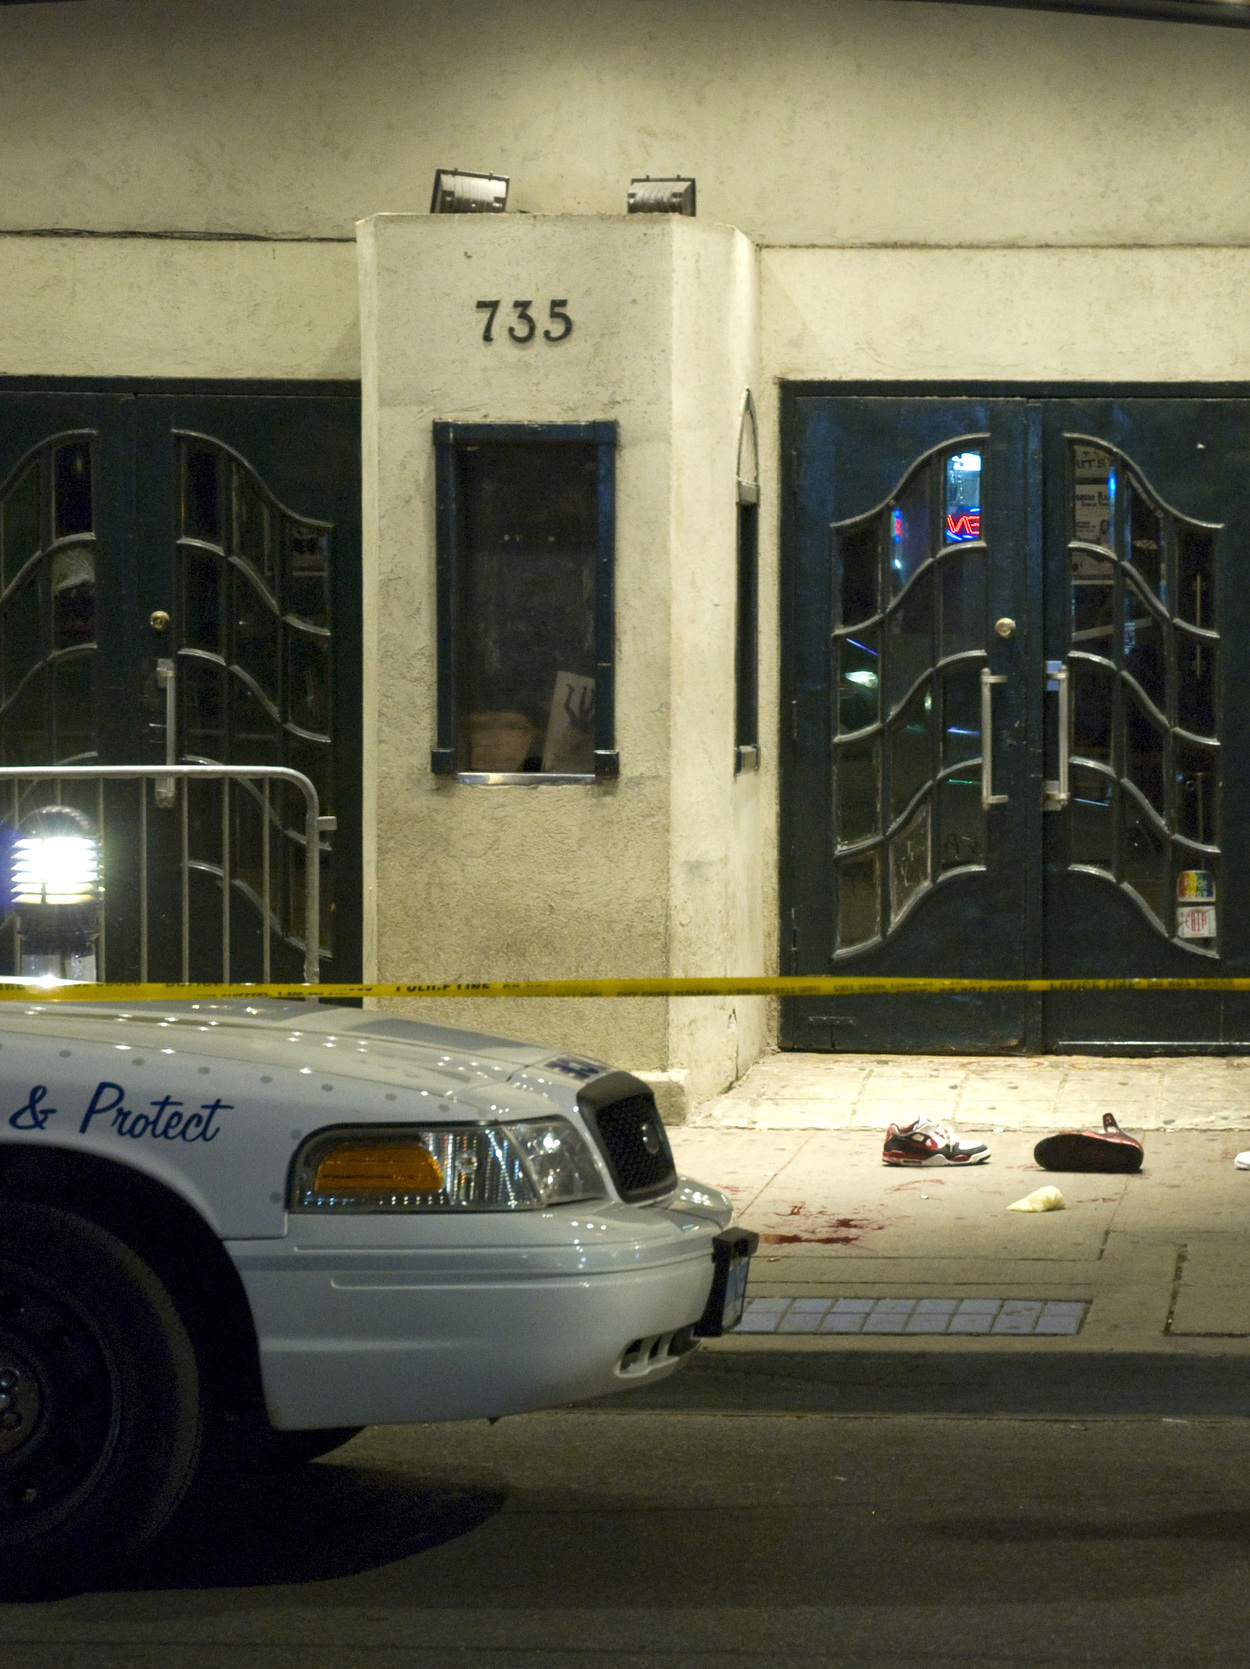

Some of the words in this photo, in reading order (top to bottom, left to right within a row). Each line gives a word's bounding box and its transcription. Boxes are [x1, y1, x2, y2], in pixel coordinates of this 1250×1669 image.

[475, 299, 573, 344] 735
[9, 1085, 57, 1130] &
[80, 1082, 234, 1142] Protect
